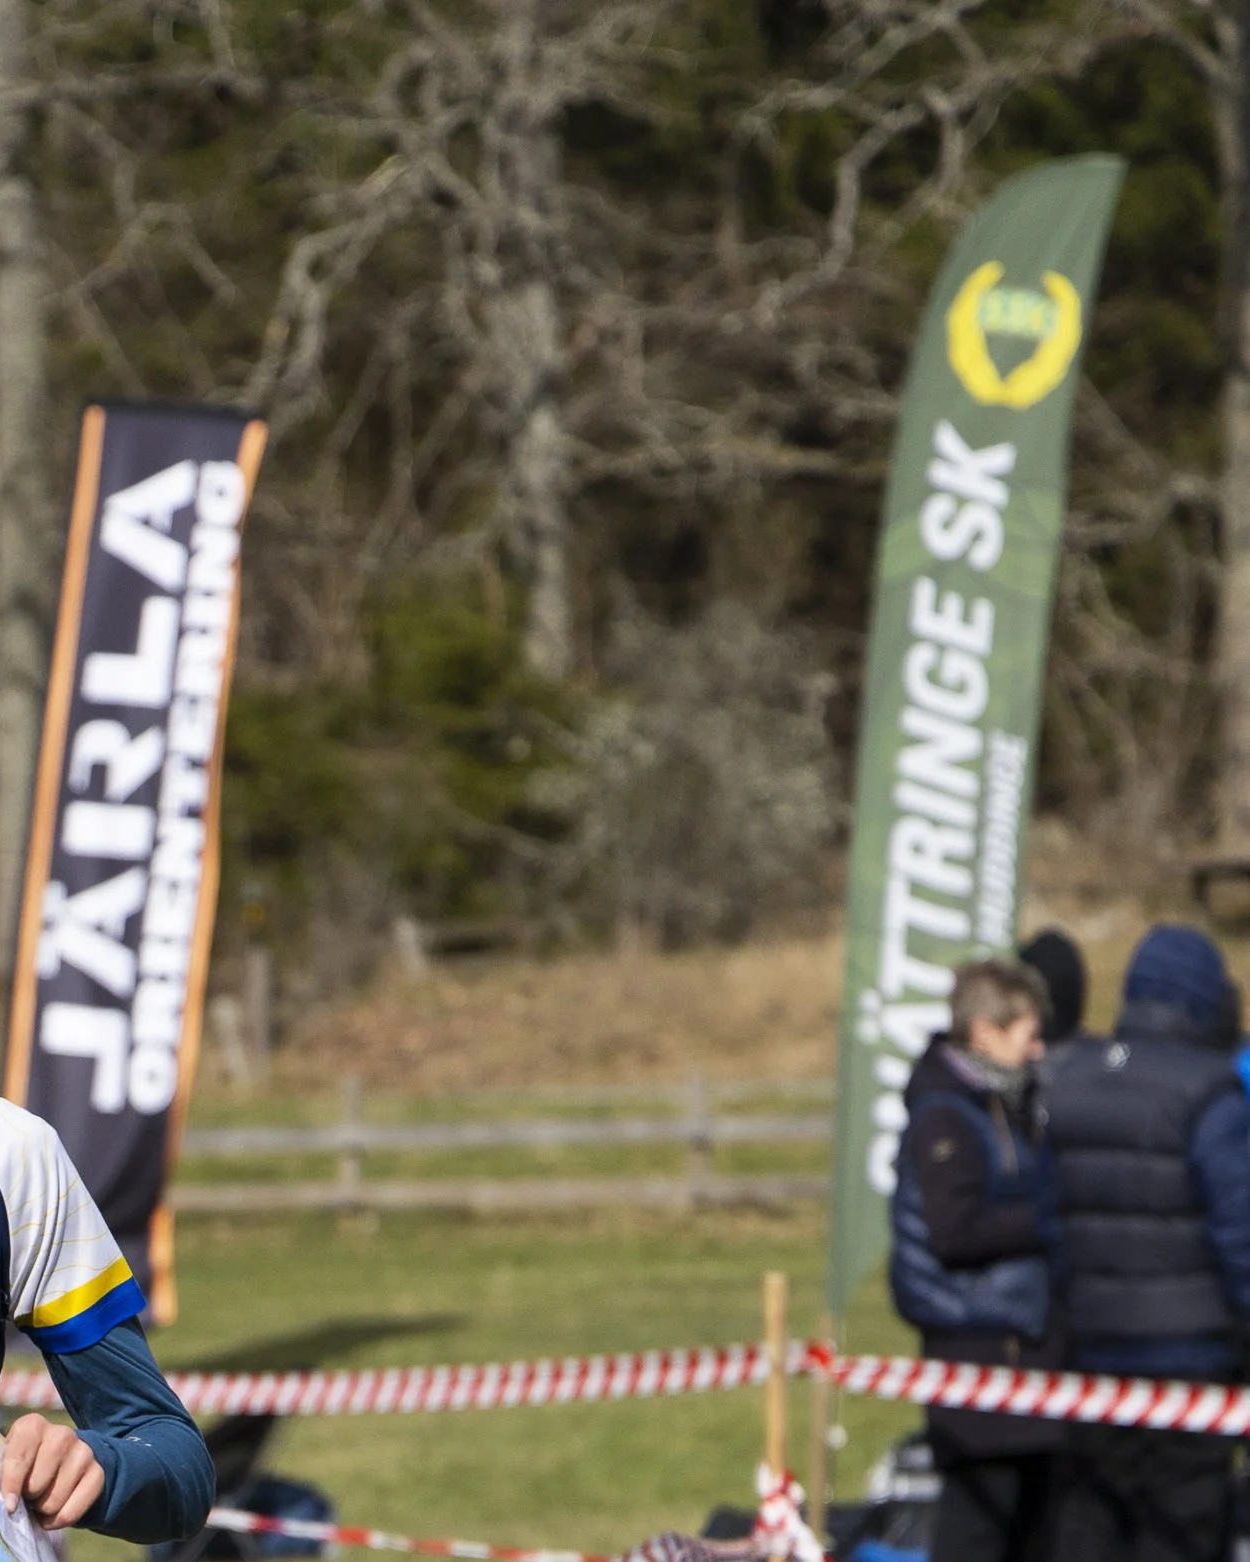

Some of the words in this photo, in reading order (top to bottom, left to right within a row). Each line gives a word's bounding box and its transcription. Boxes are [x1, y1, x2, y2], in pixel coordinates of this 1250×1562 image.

[36, 456, 198, 1115] JÄRLA
[126, 458, 246, 1117] ORIENTERING
[920, 420, 1018, 572] SK
